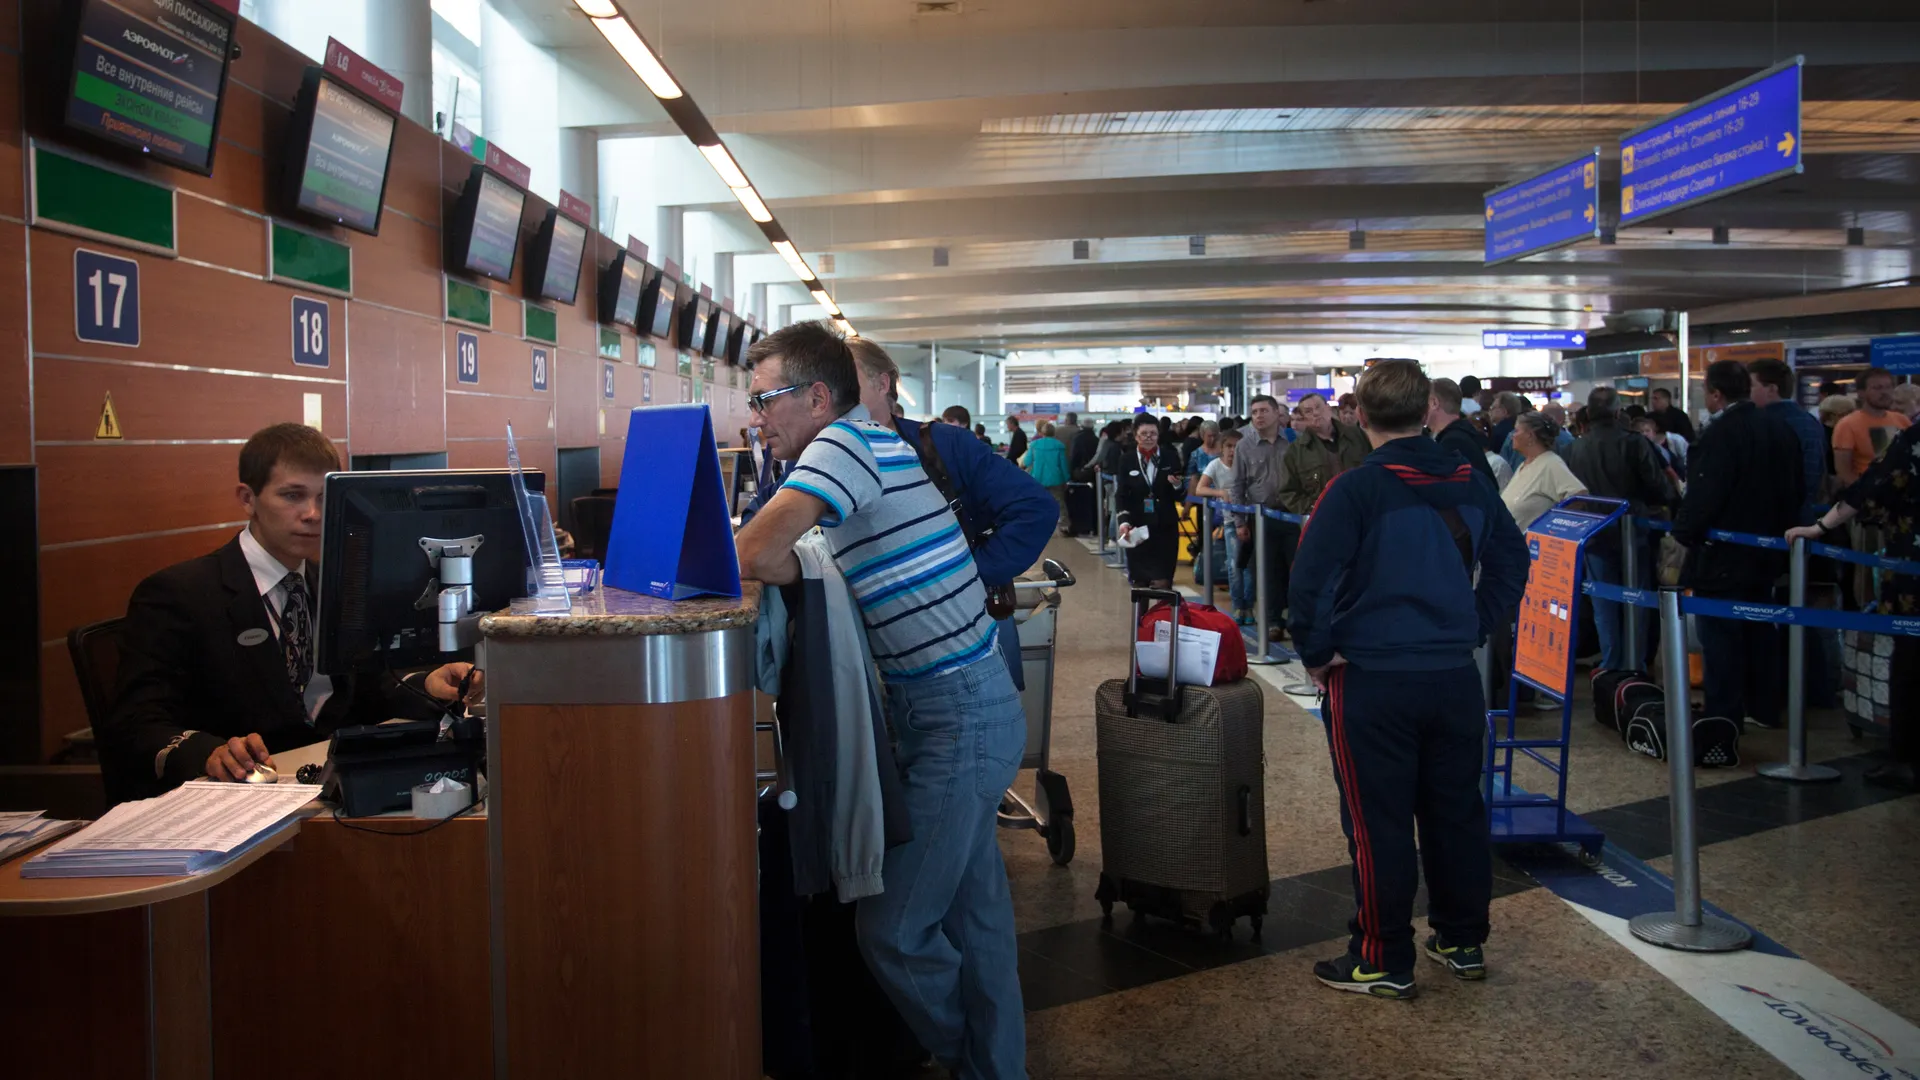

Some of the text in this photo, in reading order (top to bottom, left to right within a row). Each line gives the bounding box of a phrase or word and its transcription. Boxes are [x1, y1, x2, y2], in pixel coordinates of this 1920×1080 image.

[174, 2, 229, 42] ПАССАЖИРОВ
[122, 29, 176, 61] АЭРОФЛОТ
[337, 52, 349, 72] LG
[96, 55, 204, 115] Все внутренние рейсы
[88, 269, 128, 328] 17
[299, 309, 323, 356] 18
[461, 341, 476, 376] 19
[534, 355, 546, 385] 20
[605, 369, 614, 394] 21
[1517, 379, 1553, 390] COSTA
[1732, 605, 1774, 615] АЭРОФЛОТ
